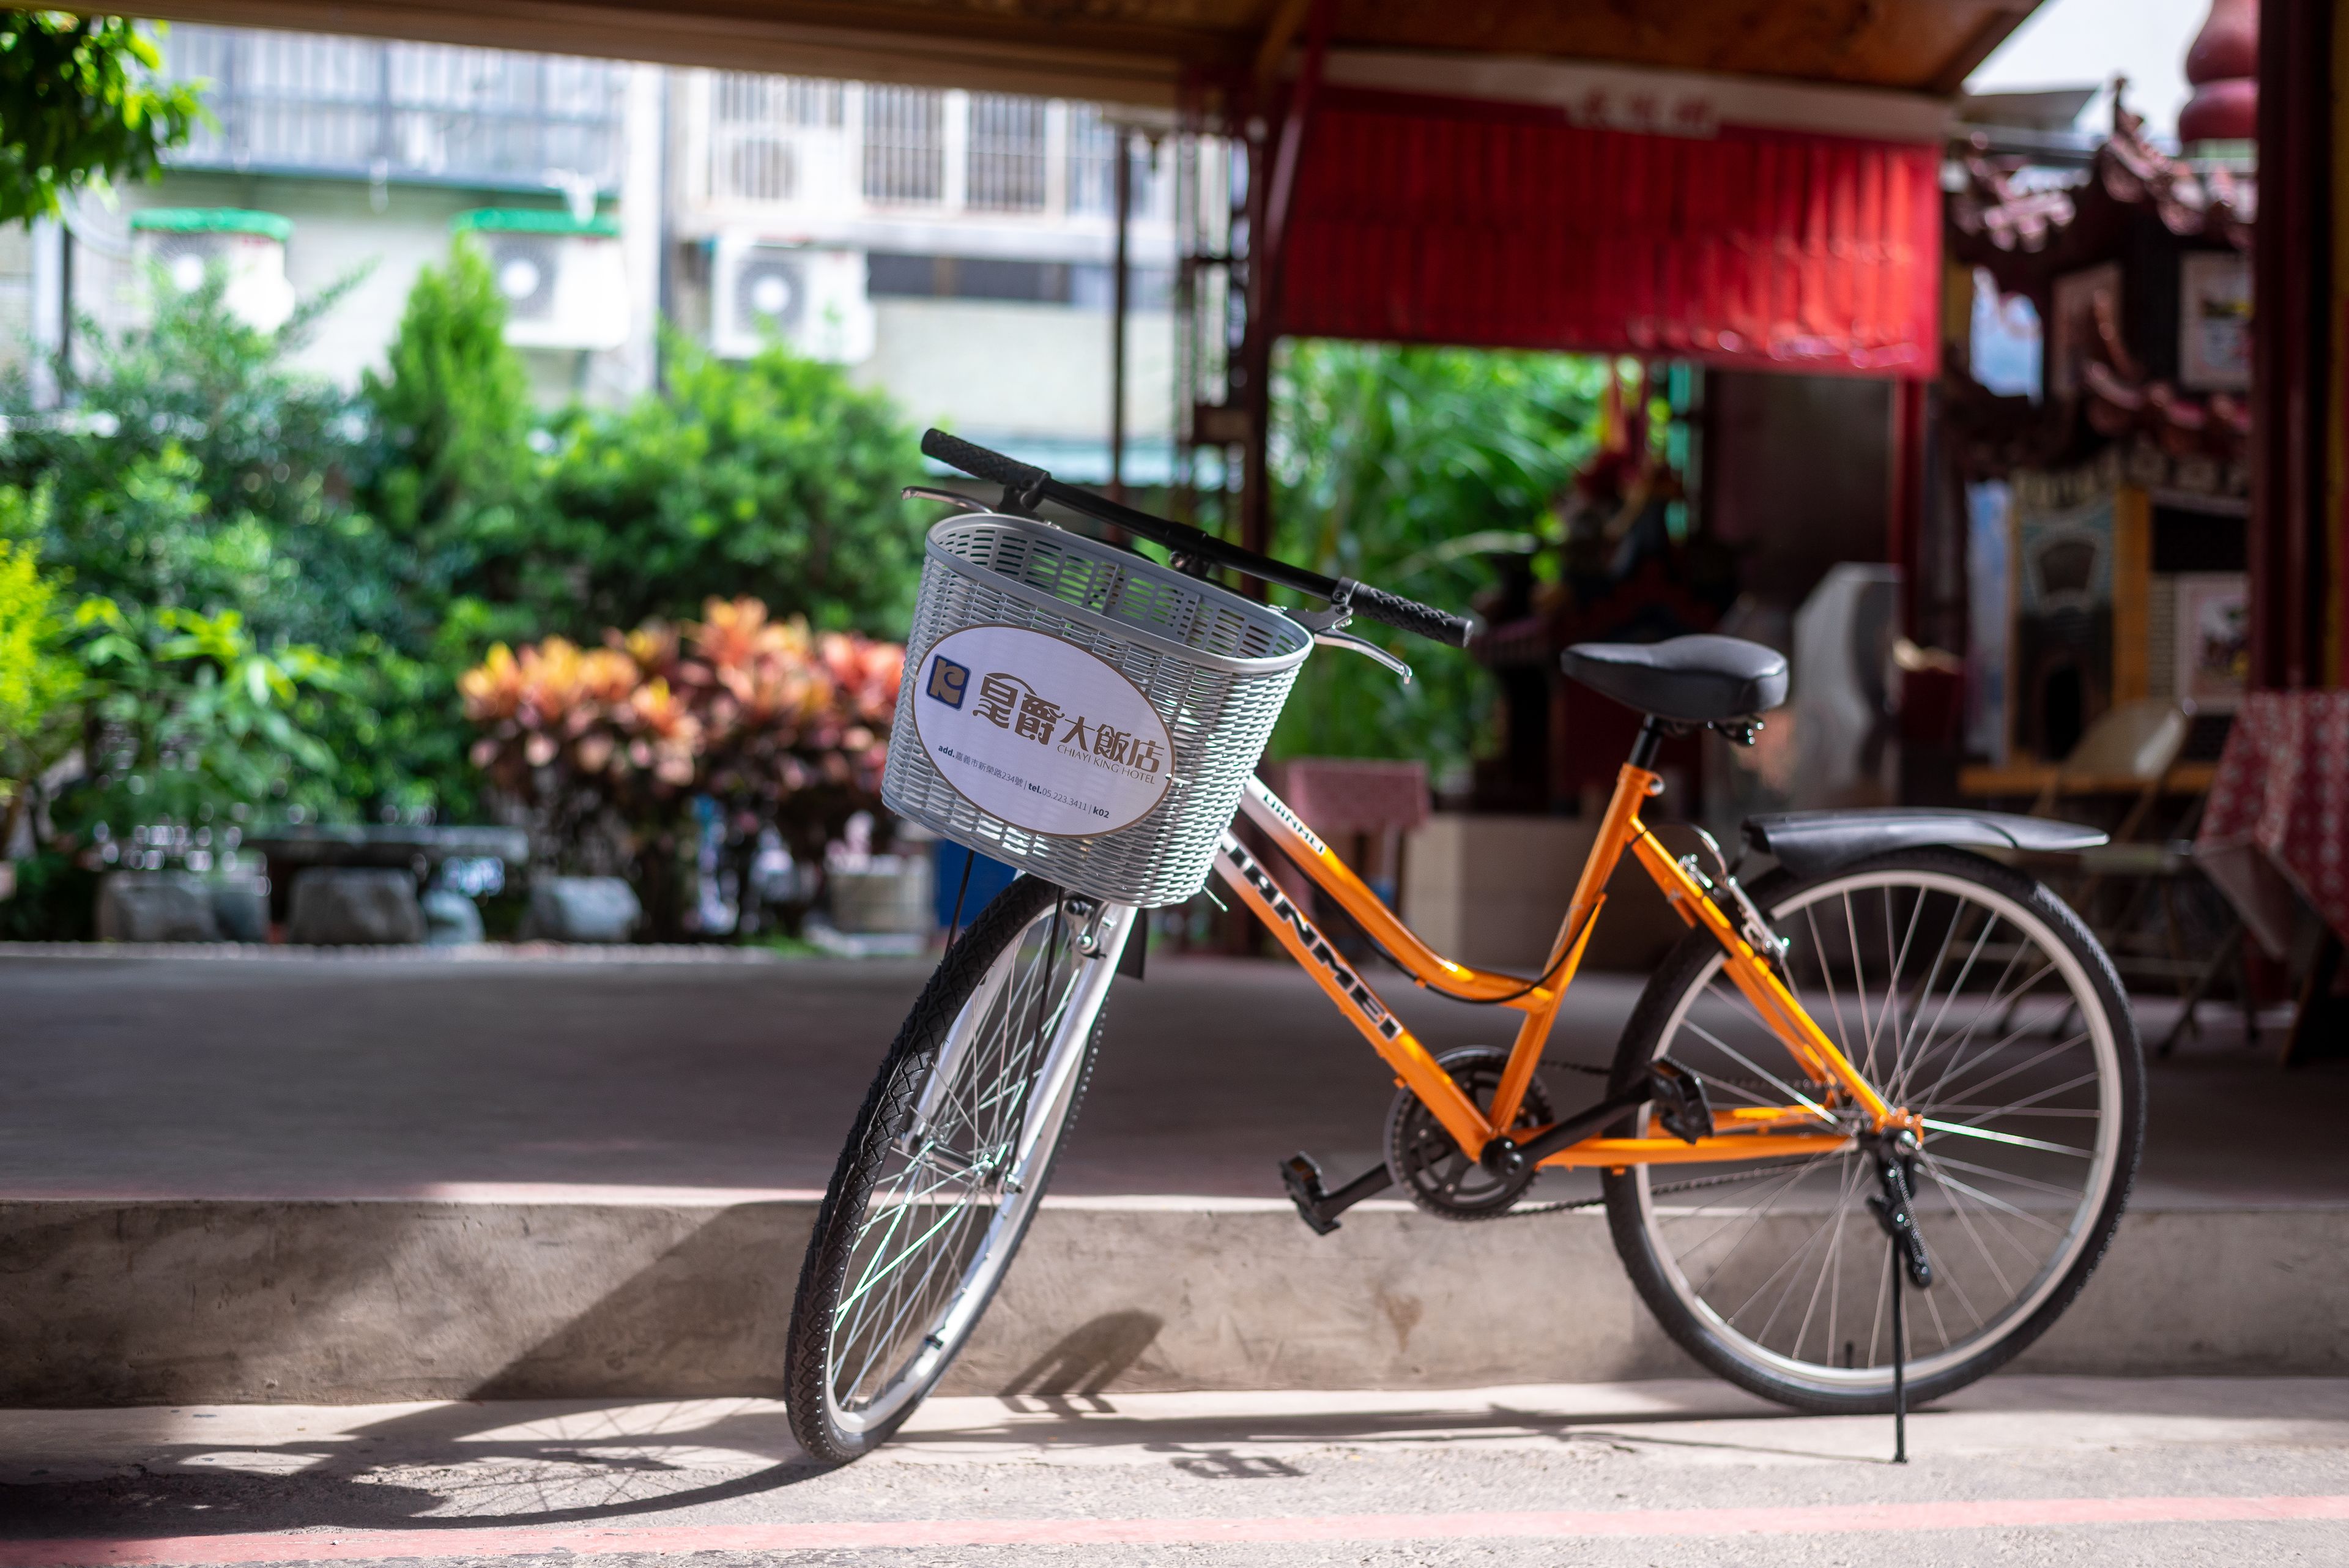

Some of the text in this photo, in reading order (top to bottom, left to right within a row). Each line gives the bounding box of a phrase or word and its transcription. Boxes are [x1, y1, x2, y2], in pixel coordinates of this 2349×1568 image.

[972, 672, 1165, 773] 皇爵大飯店
[1057, 744, 1156, 785] CHIAYI KING HOTEL
[1093, 806, 1110, 819] k02
[1220, 843, 1400, 1040] IANMEI
